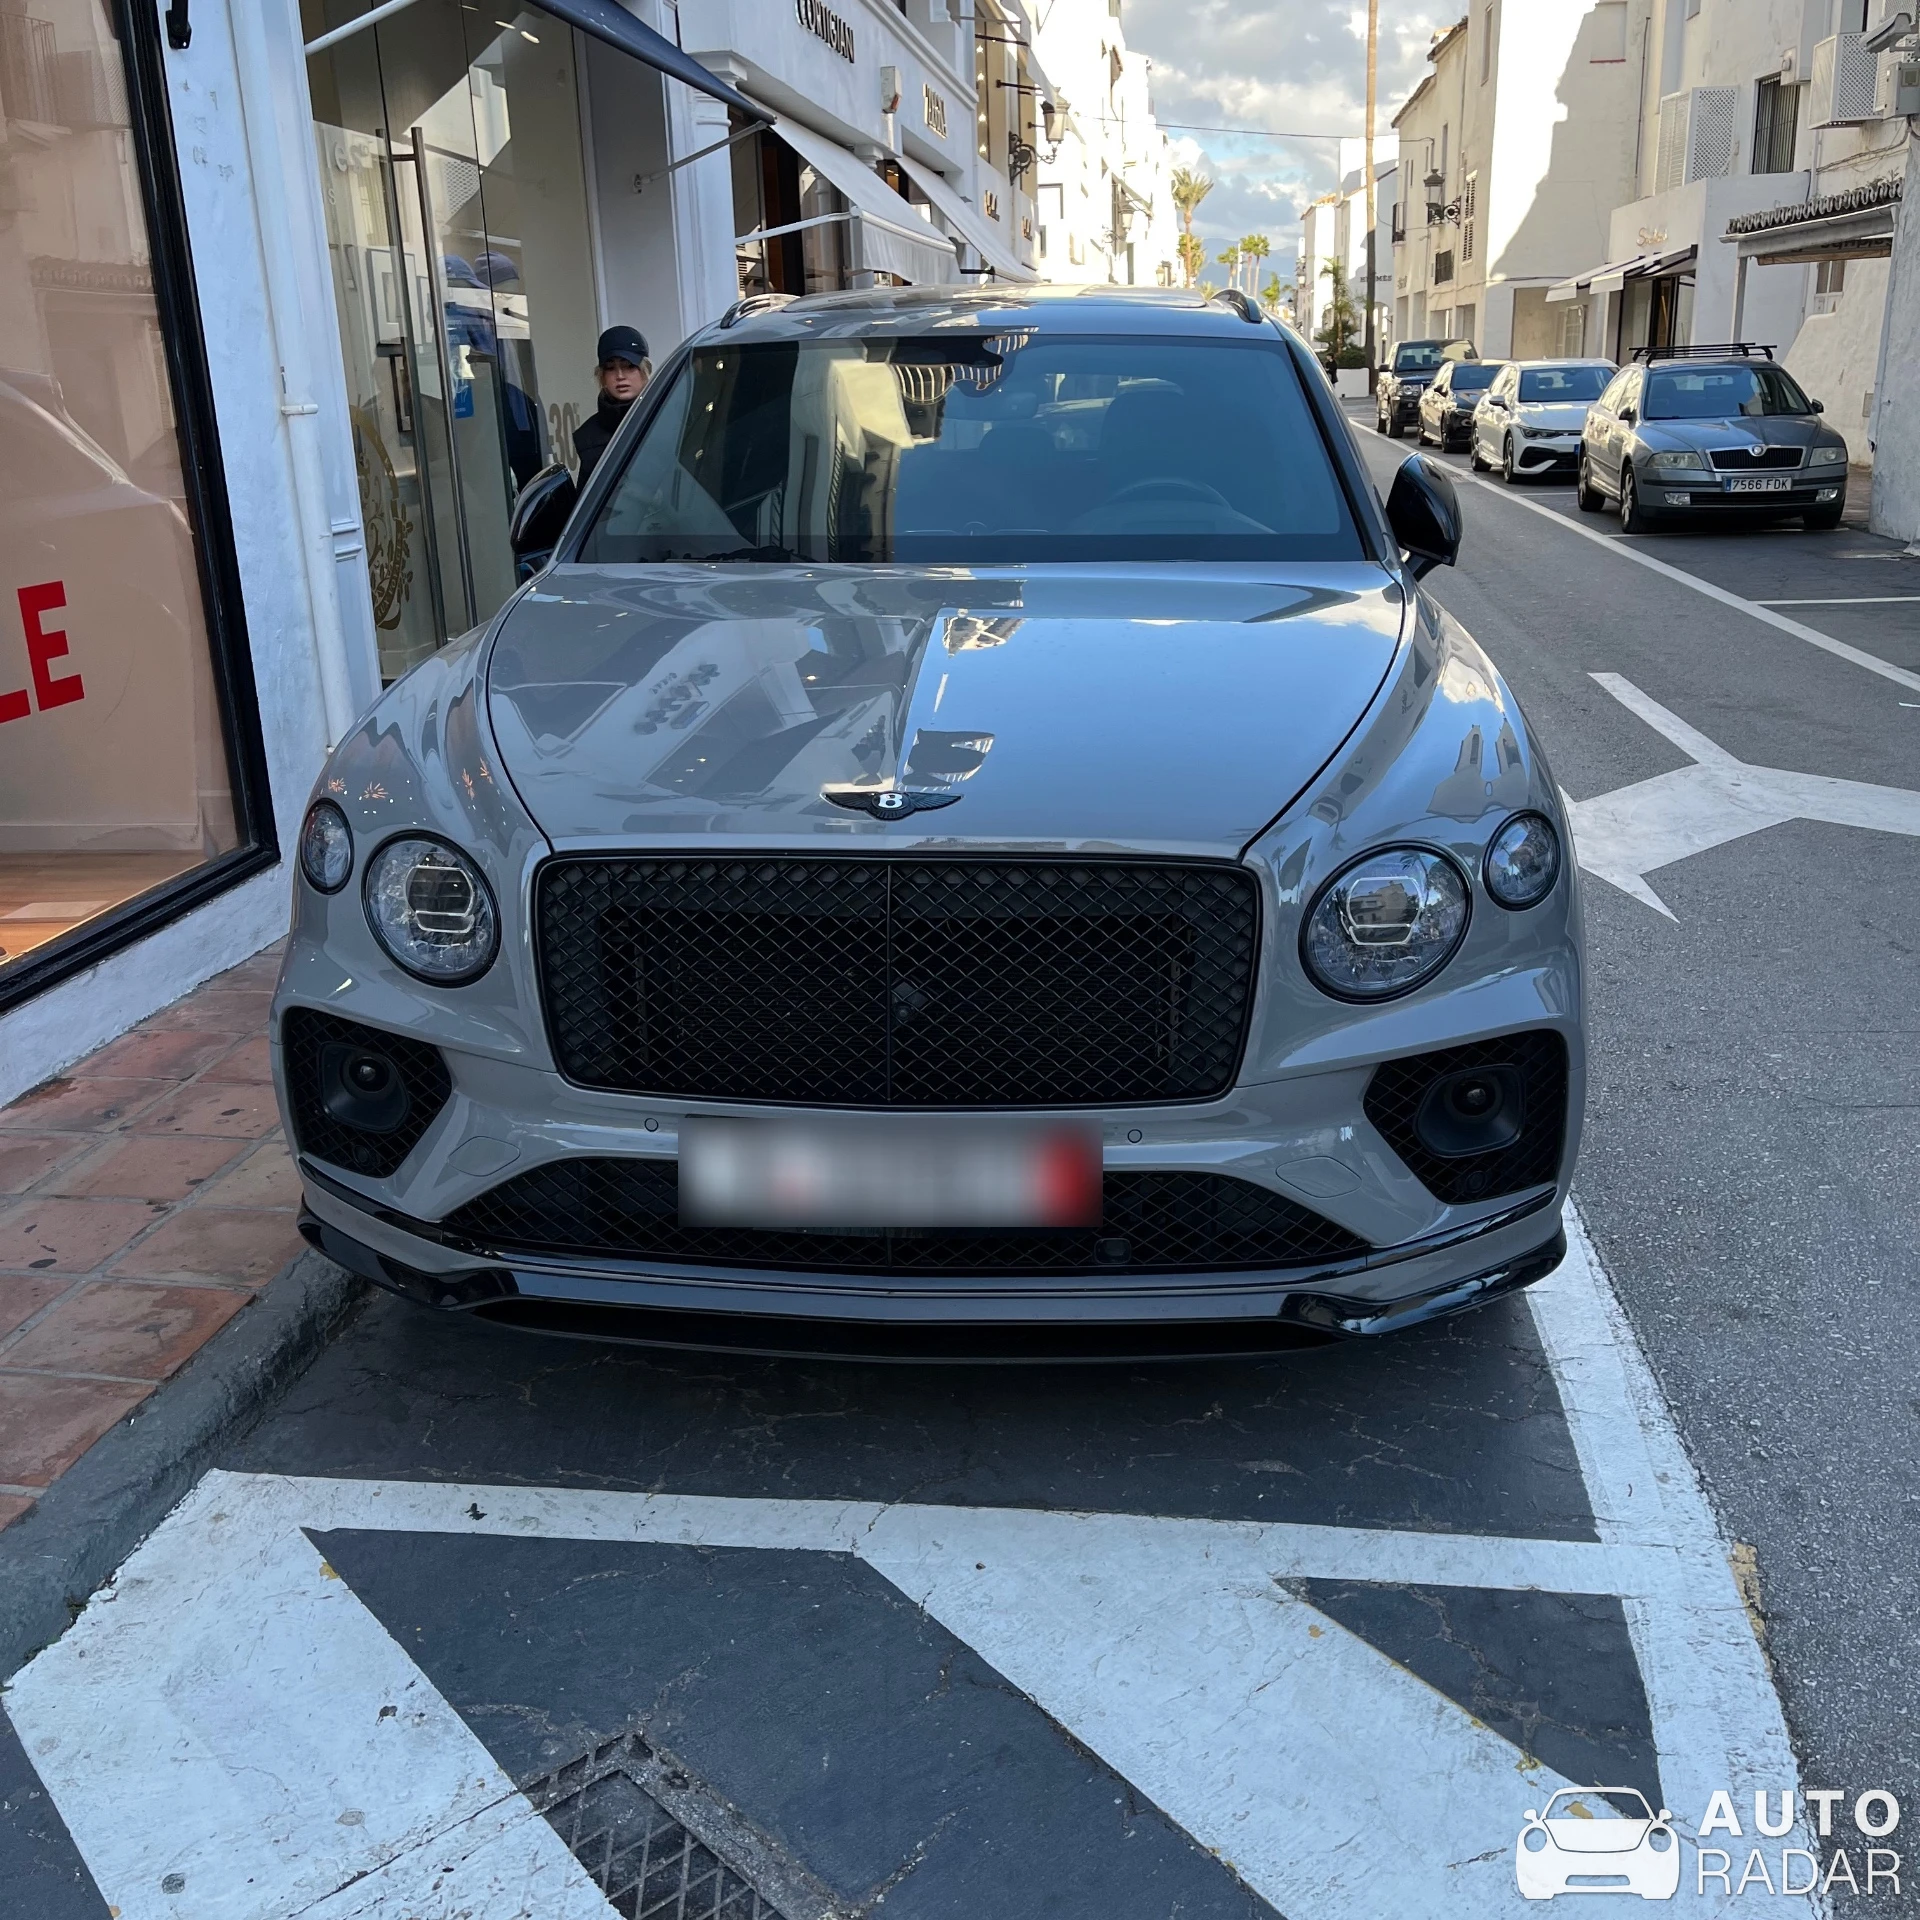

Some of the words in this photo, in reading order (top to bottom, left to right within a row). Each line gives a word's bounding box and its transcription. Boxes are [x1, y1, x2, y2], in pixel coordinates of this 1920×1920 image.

[1360, 273, 1393, 283] HMÈS
[1732, 479, 1762, 490] 7566
[1766, 478, 1788, 490] FDK
